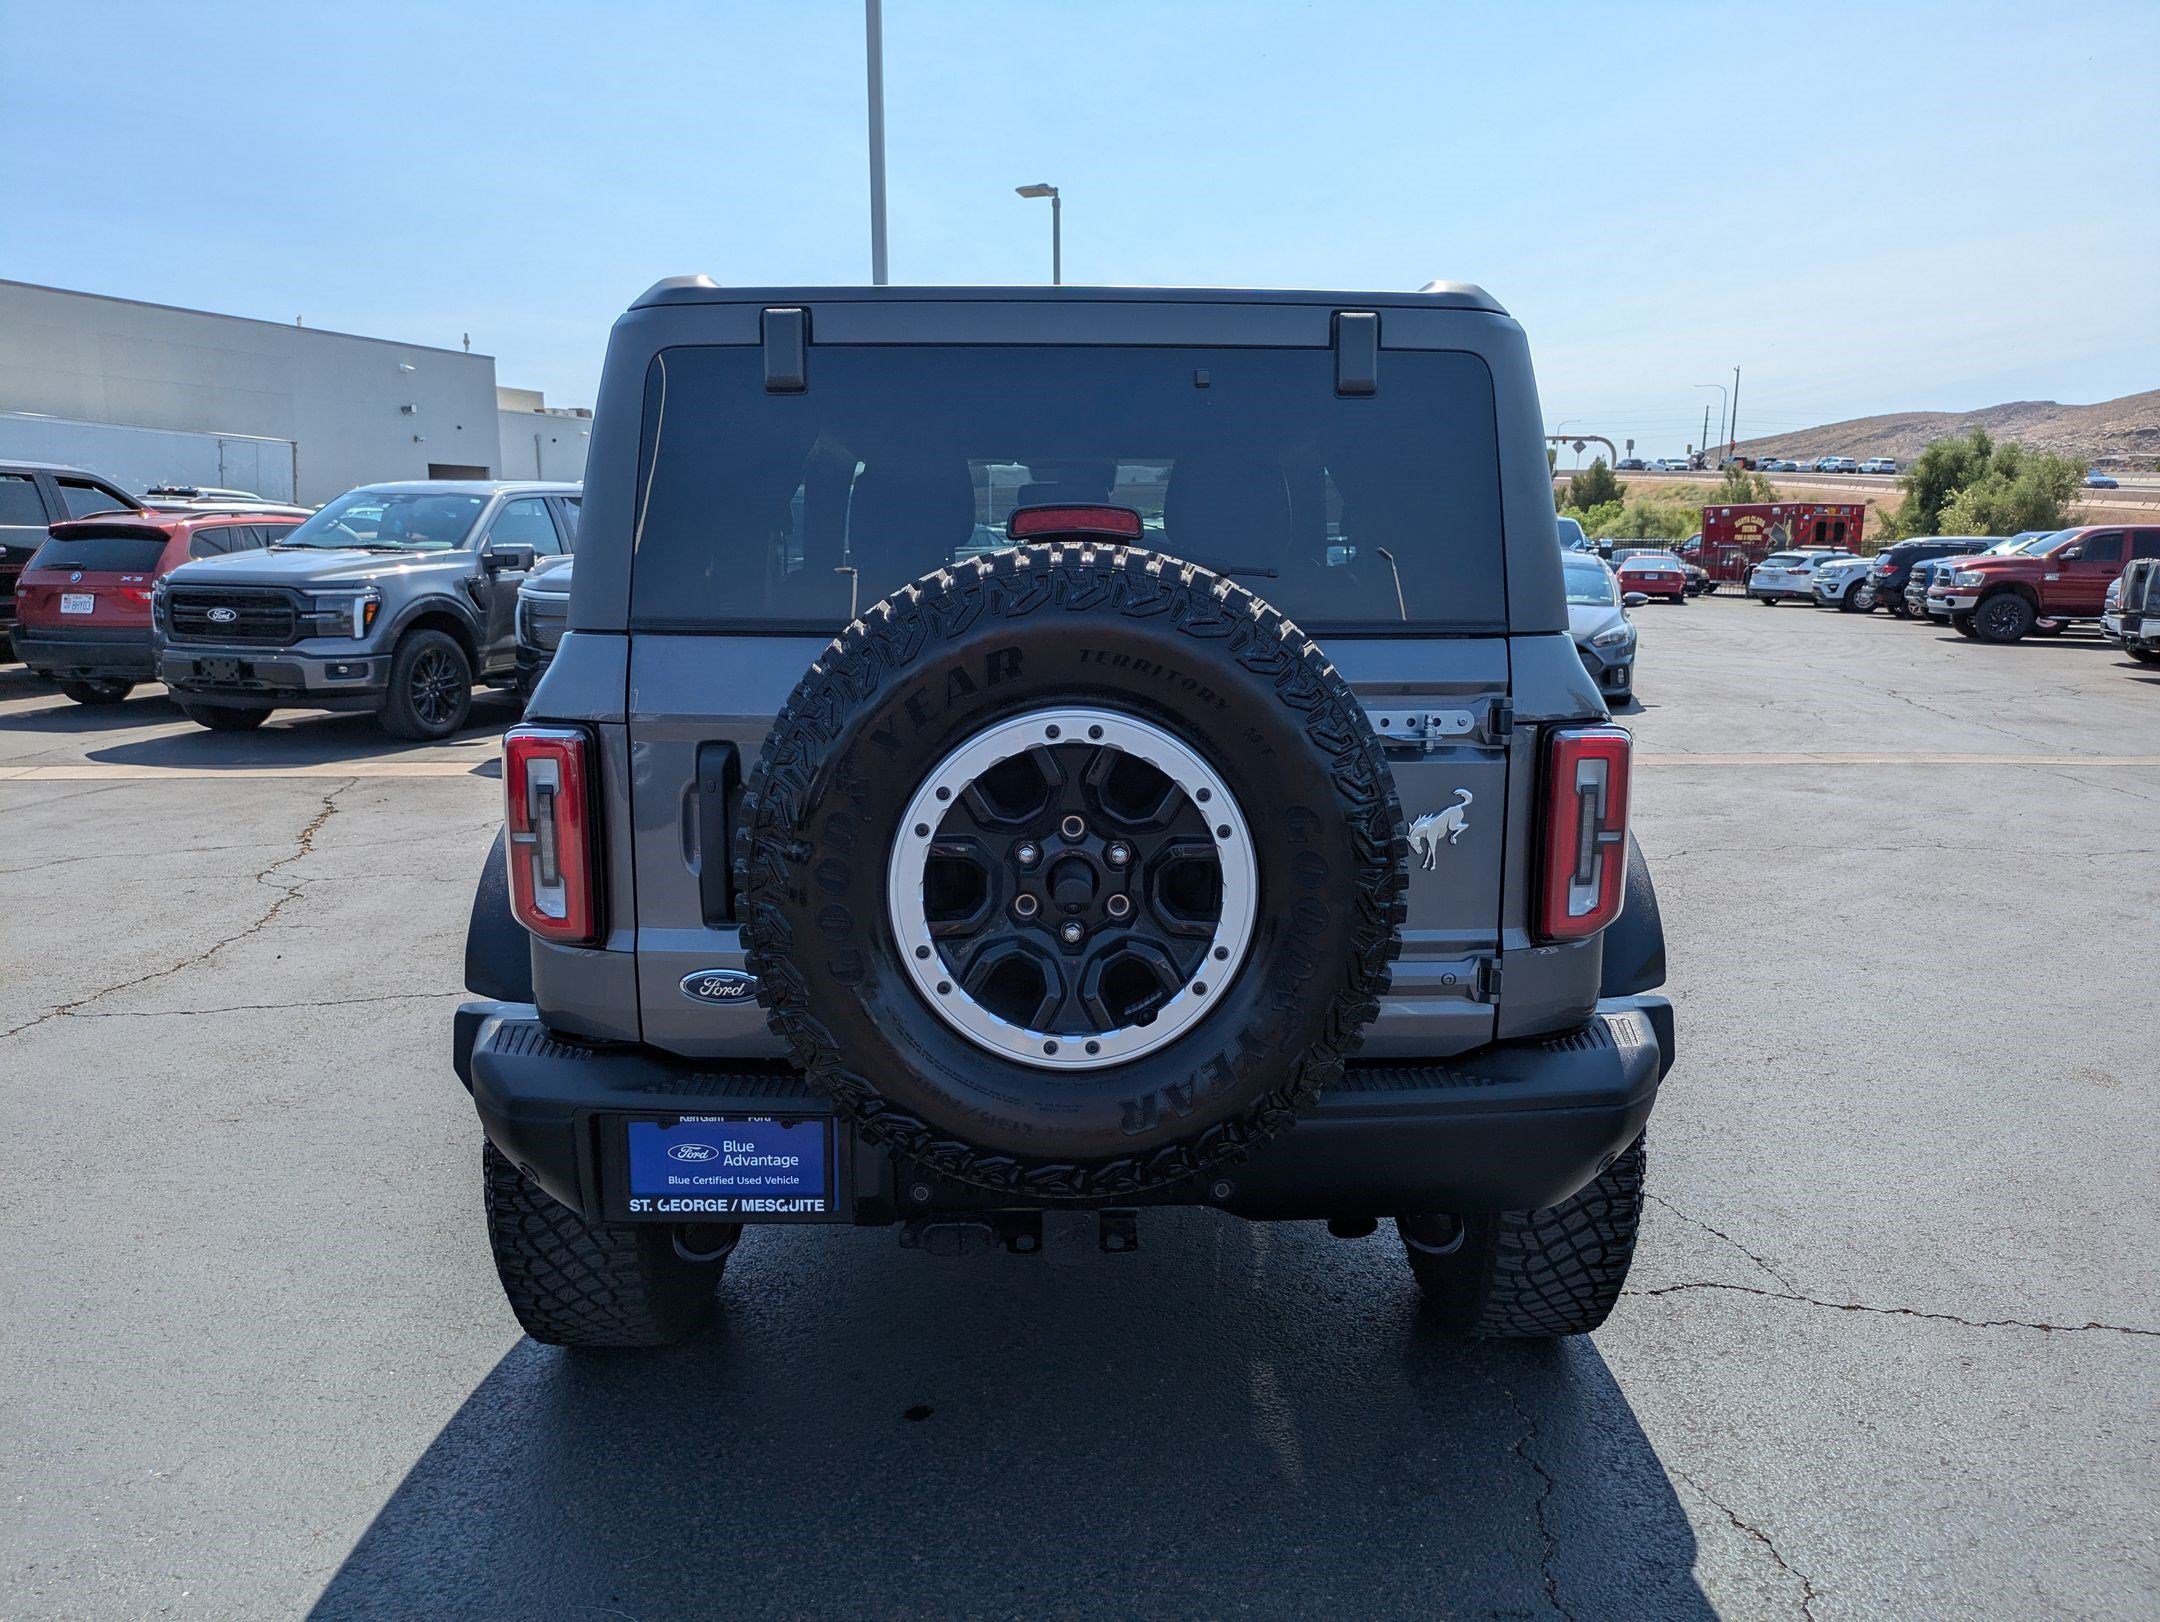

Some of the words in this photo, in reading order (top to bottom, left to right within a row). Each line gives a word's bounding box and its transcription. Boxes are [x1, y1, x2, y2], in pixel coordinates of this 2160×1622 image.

[1079, 648, 1231, 711] TERRITORY
[723, 1140, 755, 1153] Blue
[723, 1154, 799, 1168] Advantage
[668, 1175, 690, 1184] Blue
[693, 1175, 734, 1184] Certified
[737, 1176, 762, 1184] Used
[764, 1175, 800, 1184] Vehicle
[629, 1199, 653, 1212] ST.
[657, 1199, 728, 1212] GEORGE
[741, 1199, 825, 1212] MESQUITE
